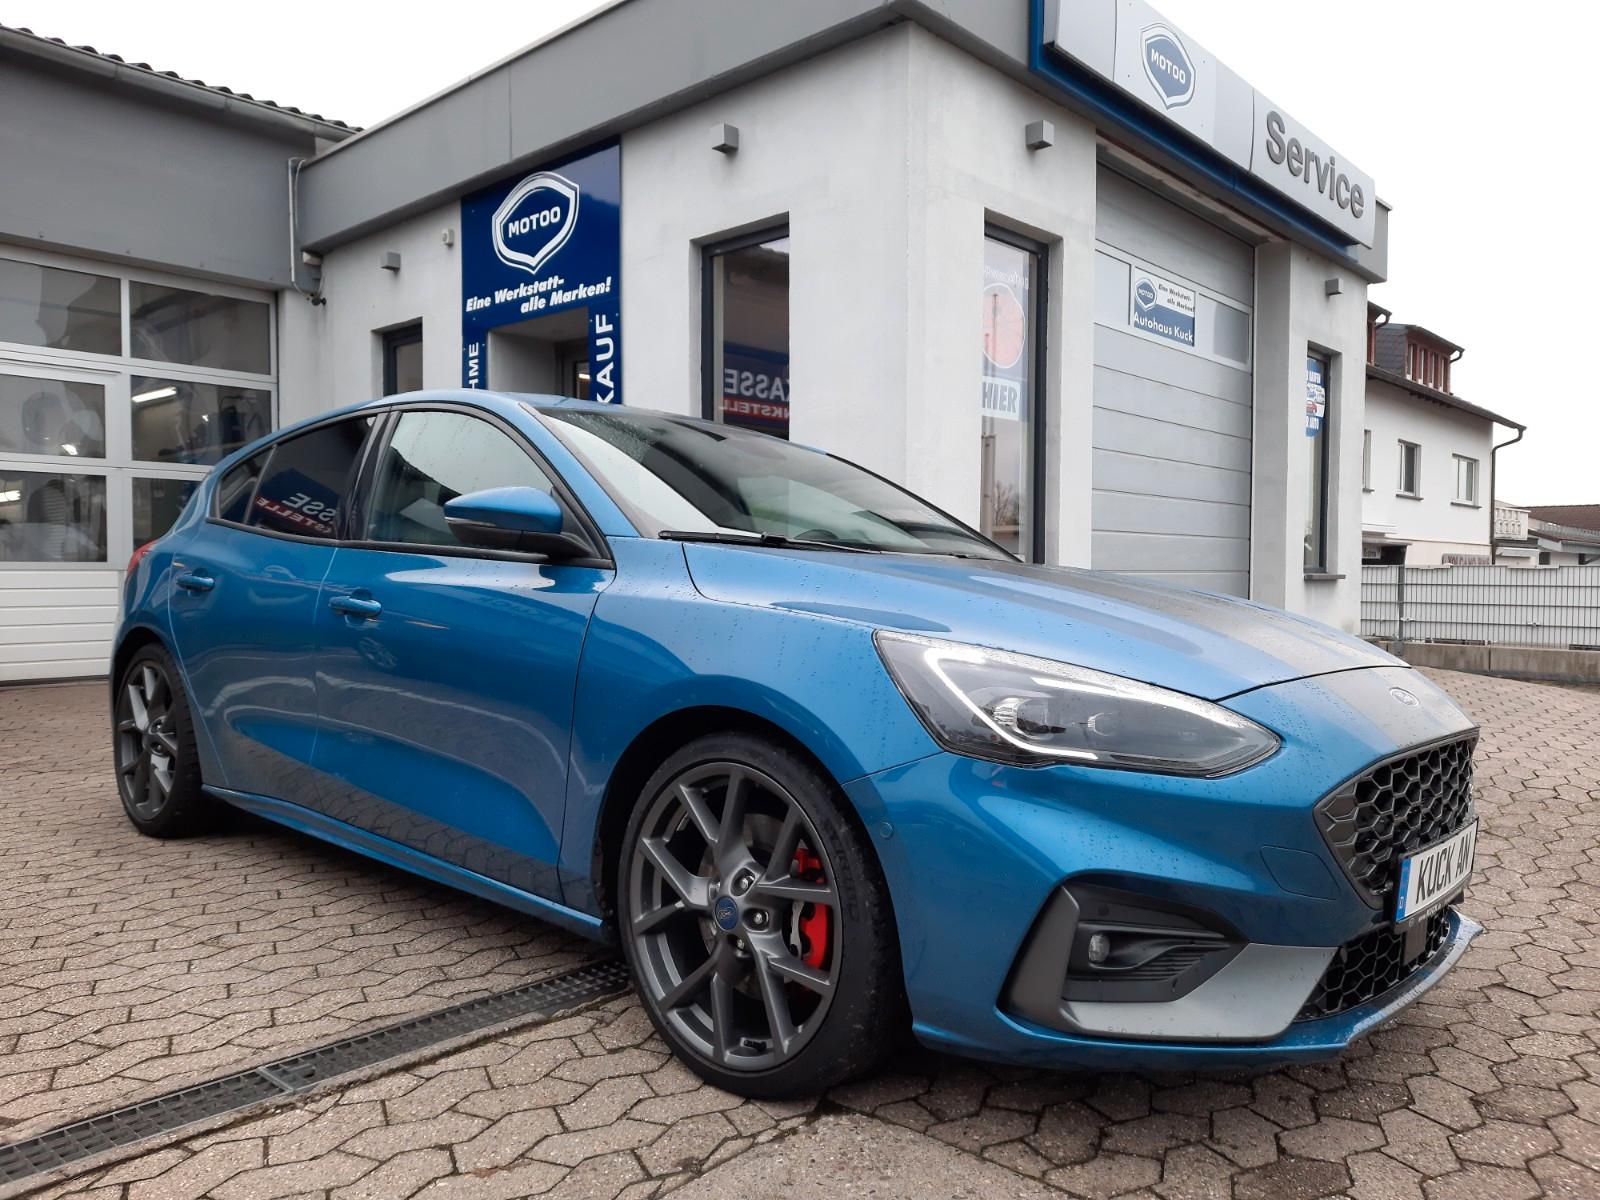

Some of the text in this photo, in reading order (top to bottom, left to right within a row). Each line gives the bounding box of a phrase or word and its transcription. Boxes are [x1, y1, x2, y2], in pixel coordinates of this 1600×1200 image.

[1151, 49, 1186, 84] MOTOO
[1266, 110, 1365, 219] Service
[508, 206, 561, 238] MOTOO
[465, 275, 564, 312] Eine Werkstatt-
[520, 276, 612, 314] alle Marken!
[1134, 311, 1193, 343] Autohaus Kuck
[983, 381, 1018, 414] HIER
[1415, 842, 1456, 904] KUCK
[1455, 831, 1472, 878] AN
